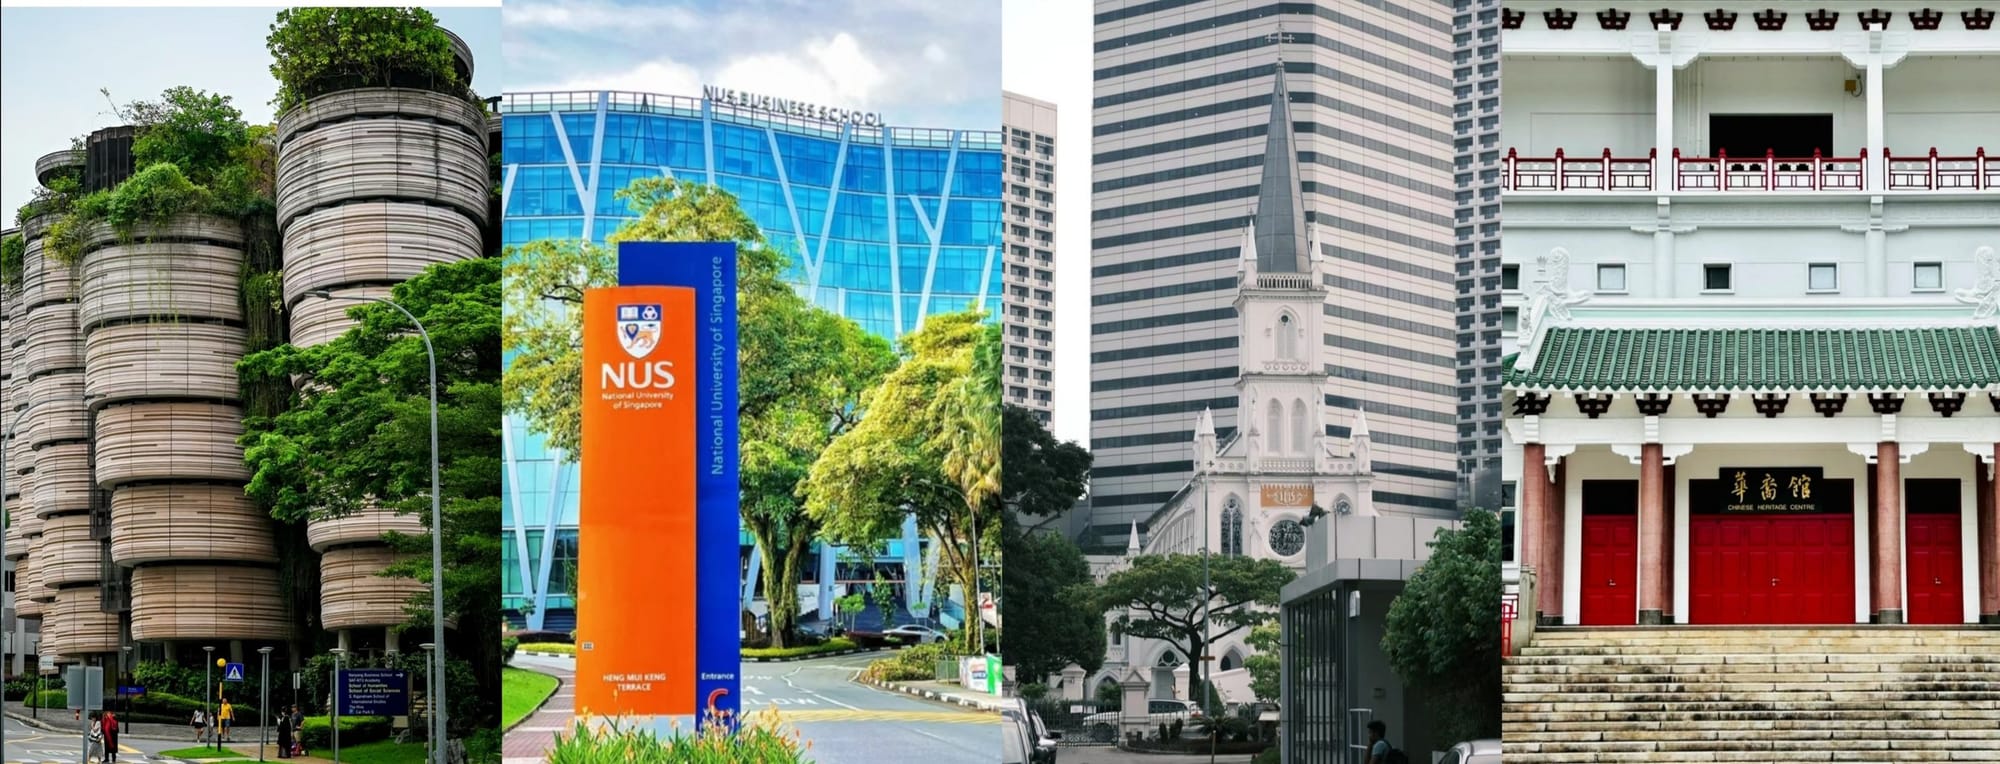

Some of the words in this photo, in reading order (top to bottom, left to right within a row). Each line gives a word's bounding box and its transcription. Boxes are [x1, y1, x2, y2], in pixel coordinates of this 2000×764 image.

[703, 84, 738, 105] NUS
[740, 91, 815, 118] BUSINESS
[818, 106, 886, 127] SCHOOL
[710, 256, 726, 323] Singapore
[710, 326, 723, 342] of
[601, 361, 675, 389] NUS
[710, 344, 725, 411] University
[602, 392, 634, 400] National
[636, 392, 674, 401] University
[624, 402, 662, 410] Singapore
[711, 415, 724, 475] National
[1731, 471, 1812, 503] 華裔館
[602, 673, 625, 682] HENG
[626, 673, 643, 681] MUI
[644, 672, 666, 681] KENG
[617, 683, 651, 691] TERRACE
[701, 672, 734, 680] Entrance
